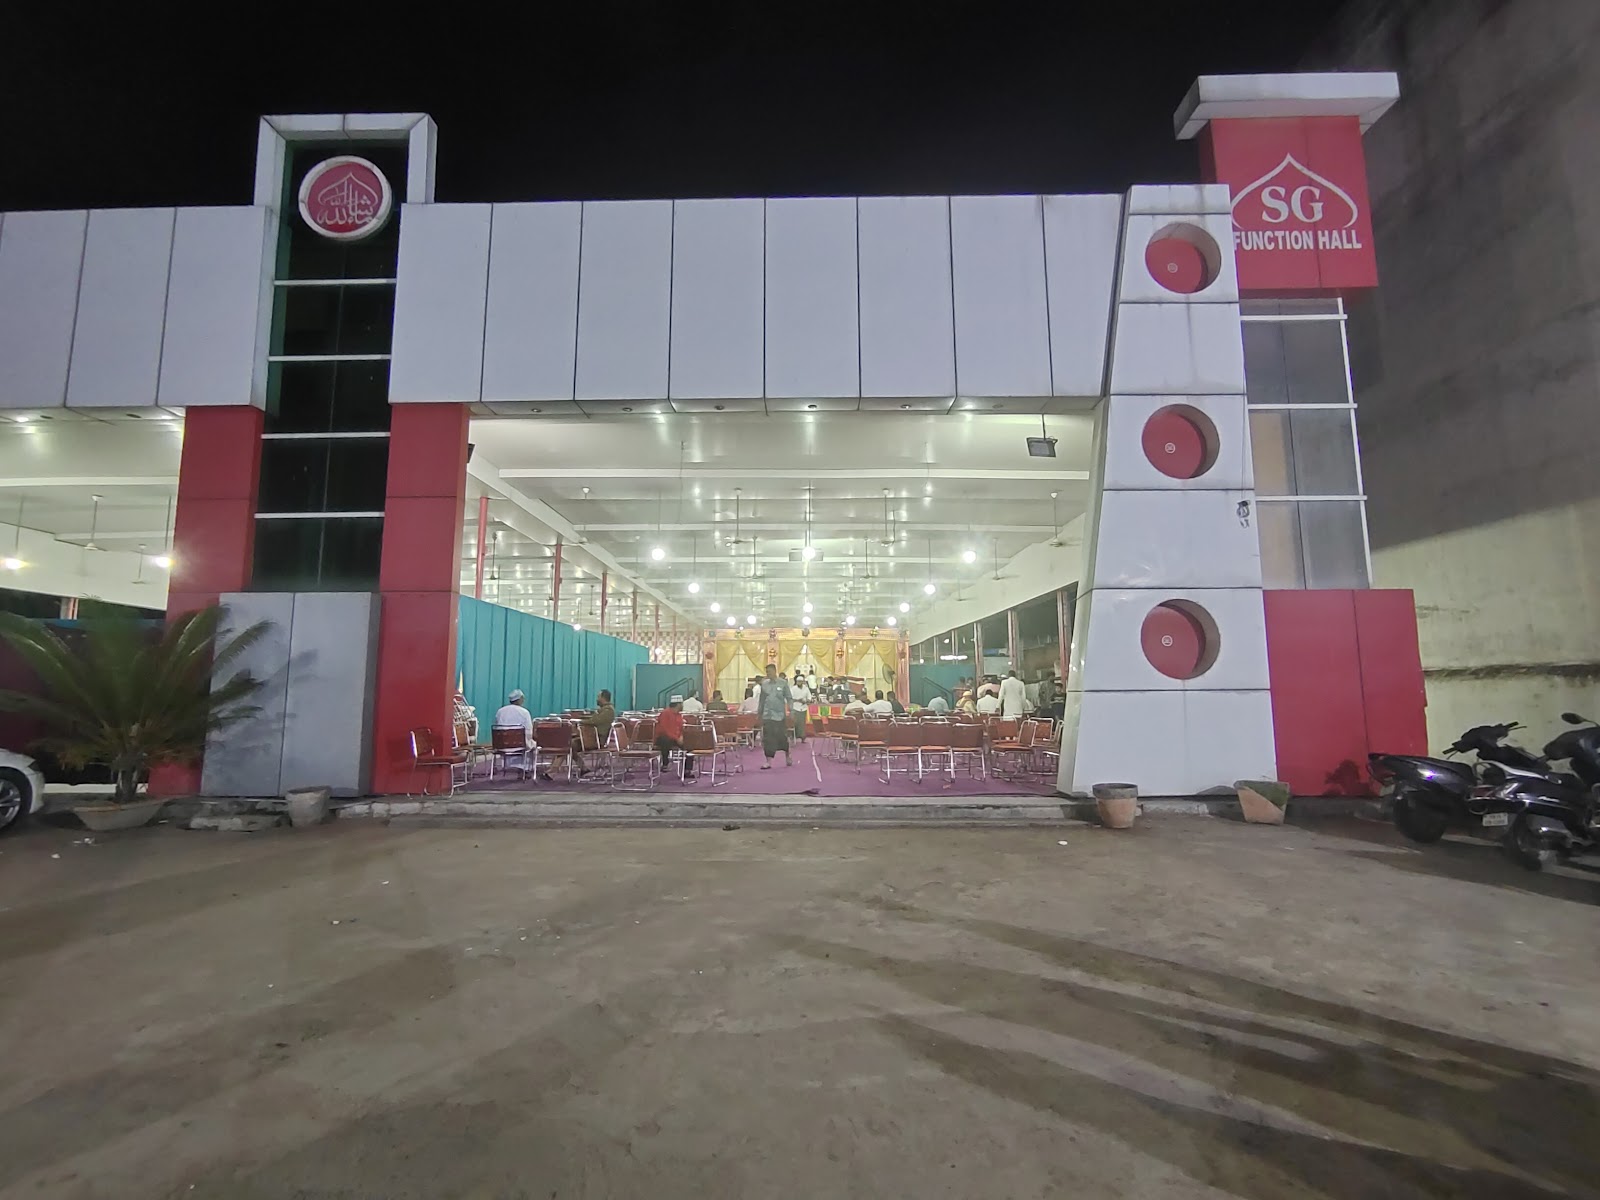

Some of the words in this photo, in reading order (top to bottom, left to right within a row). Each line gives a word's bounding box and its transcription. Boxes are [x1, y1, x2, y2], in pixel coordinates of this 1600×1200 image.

[1261, 185, 1324, 223] SG
[1232, 230, 1314, 251] FUNCTION
[1317, 229, 1362, 250] HALL
